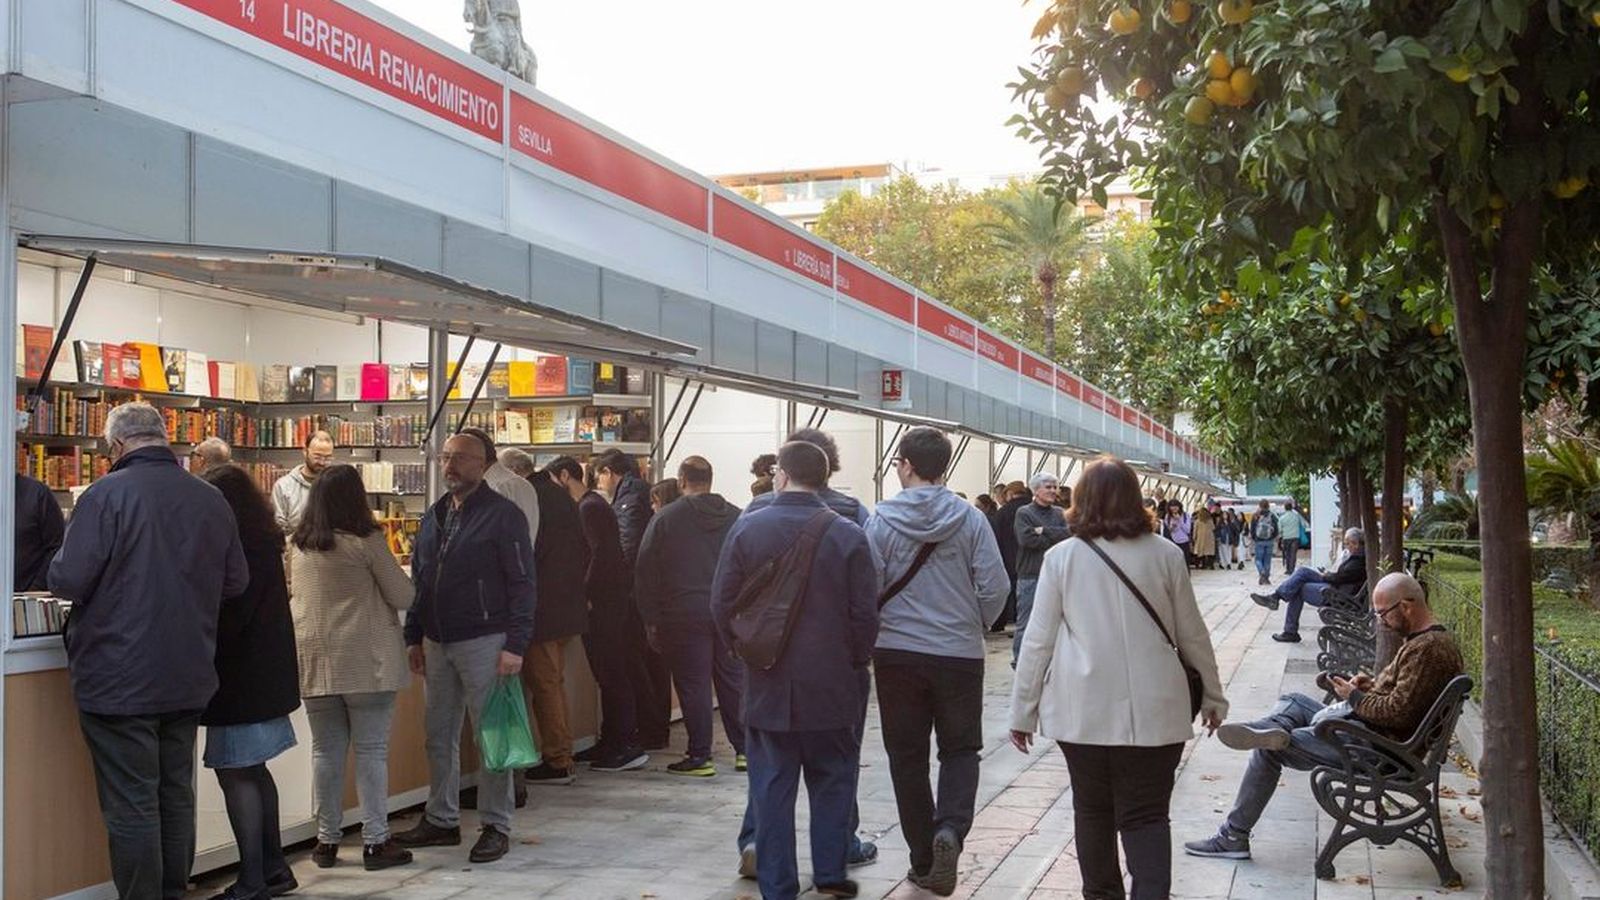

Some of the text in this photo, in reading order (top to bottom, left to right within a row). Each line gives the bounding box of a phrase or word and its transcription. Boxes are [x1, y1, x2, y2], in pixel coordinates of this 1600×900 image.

[239, 0, 499, 130] 14 LIBRERIA RENACIMIENTO
[518, 125, 553, 156] SEVILLA
